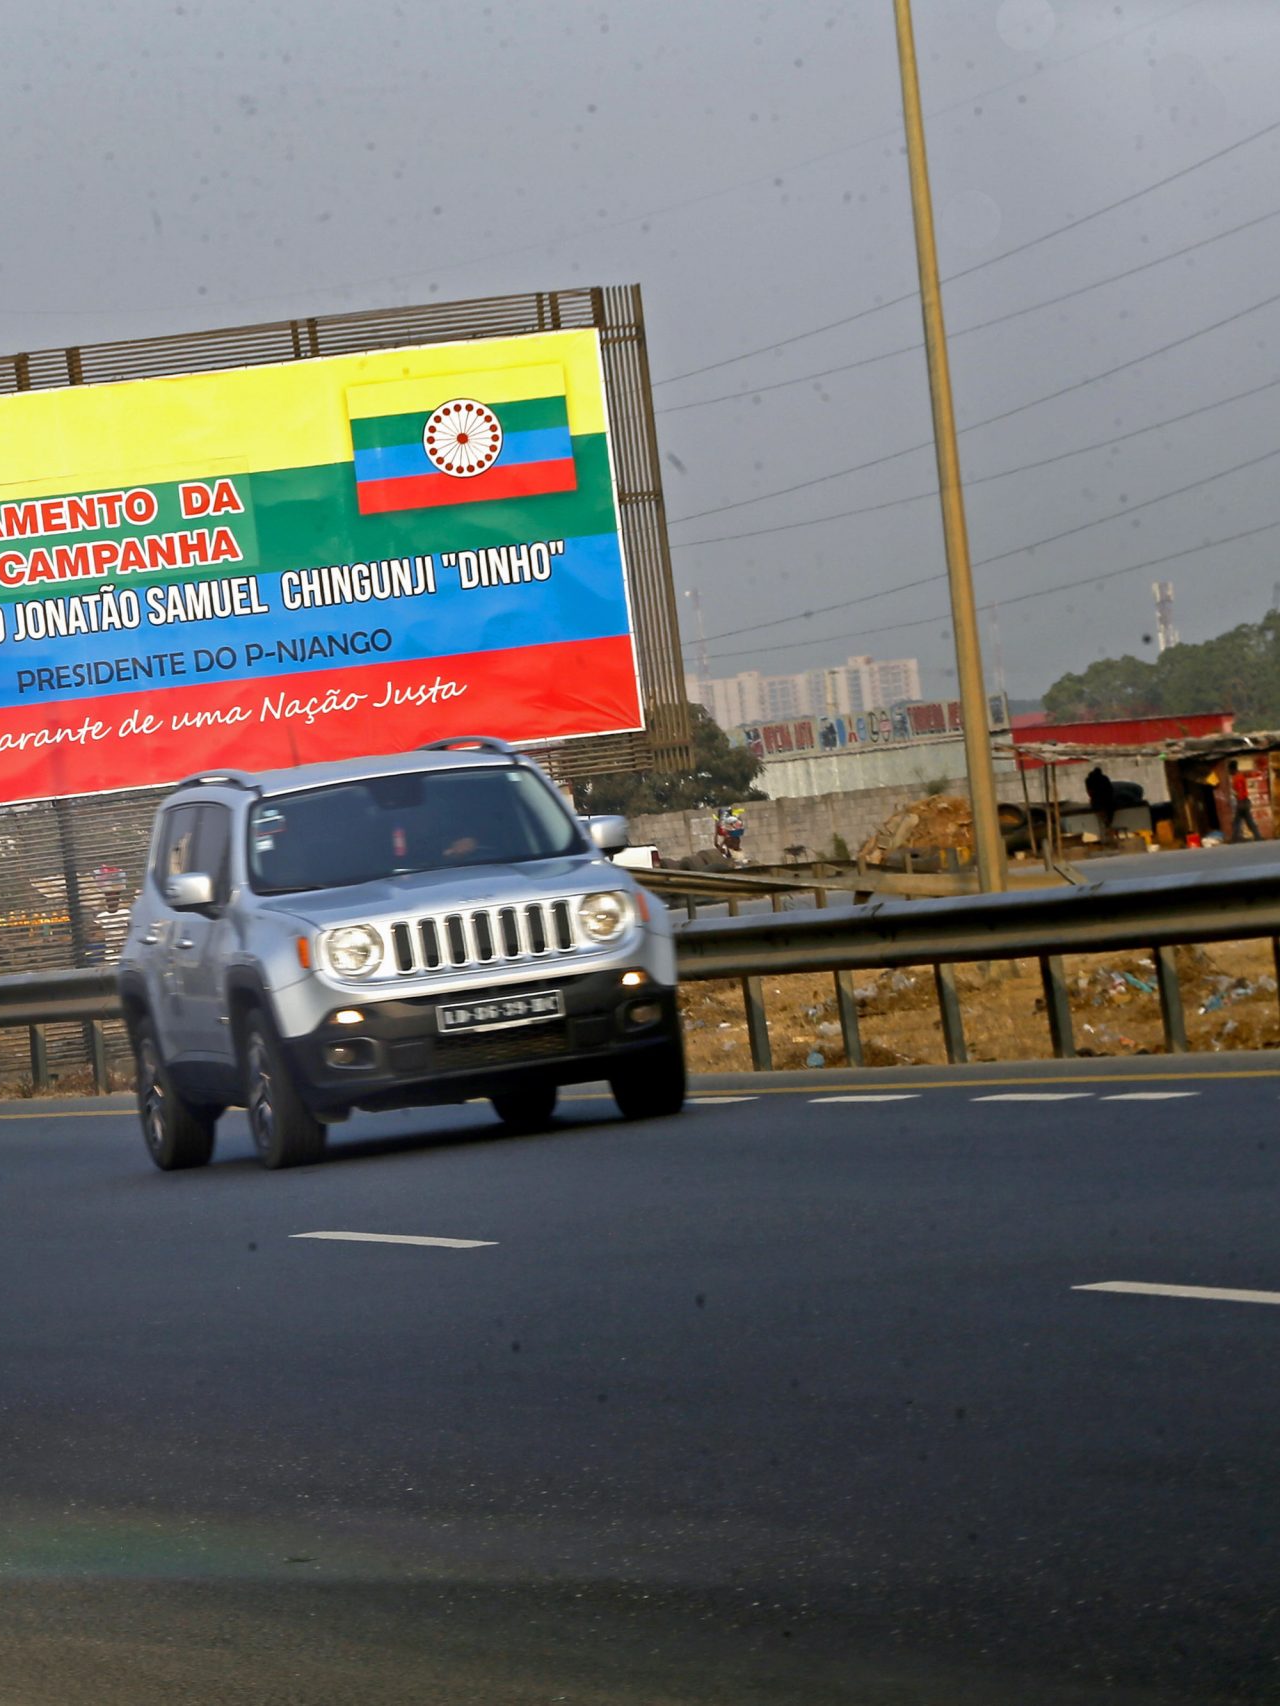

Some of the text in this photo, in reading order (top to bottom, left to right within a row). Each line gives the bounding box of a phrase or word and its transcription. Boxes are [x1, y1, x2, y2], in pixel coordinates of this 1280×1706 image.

[178, 479, 246, 519] DA
[13, 584, 141, 643] JONATÃO
[146, 575, 269, 626] SAMUEL
[280, 555, 437, 610] CHINGUNJI
[441, 539, 565, 590] "DINHO"
[17, 628, 393, 693] PRESIDENTE DO P-NJANGO
[118, 709, 164, 738] de
[171, 706, 252, 731] uma
[259, 689, 369, 725] Nação
[372, 676, 468, 708] Justa
